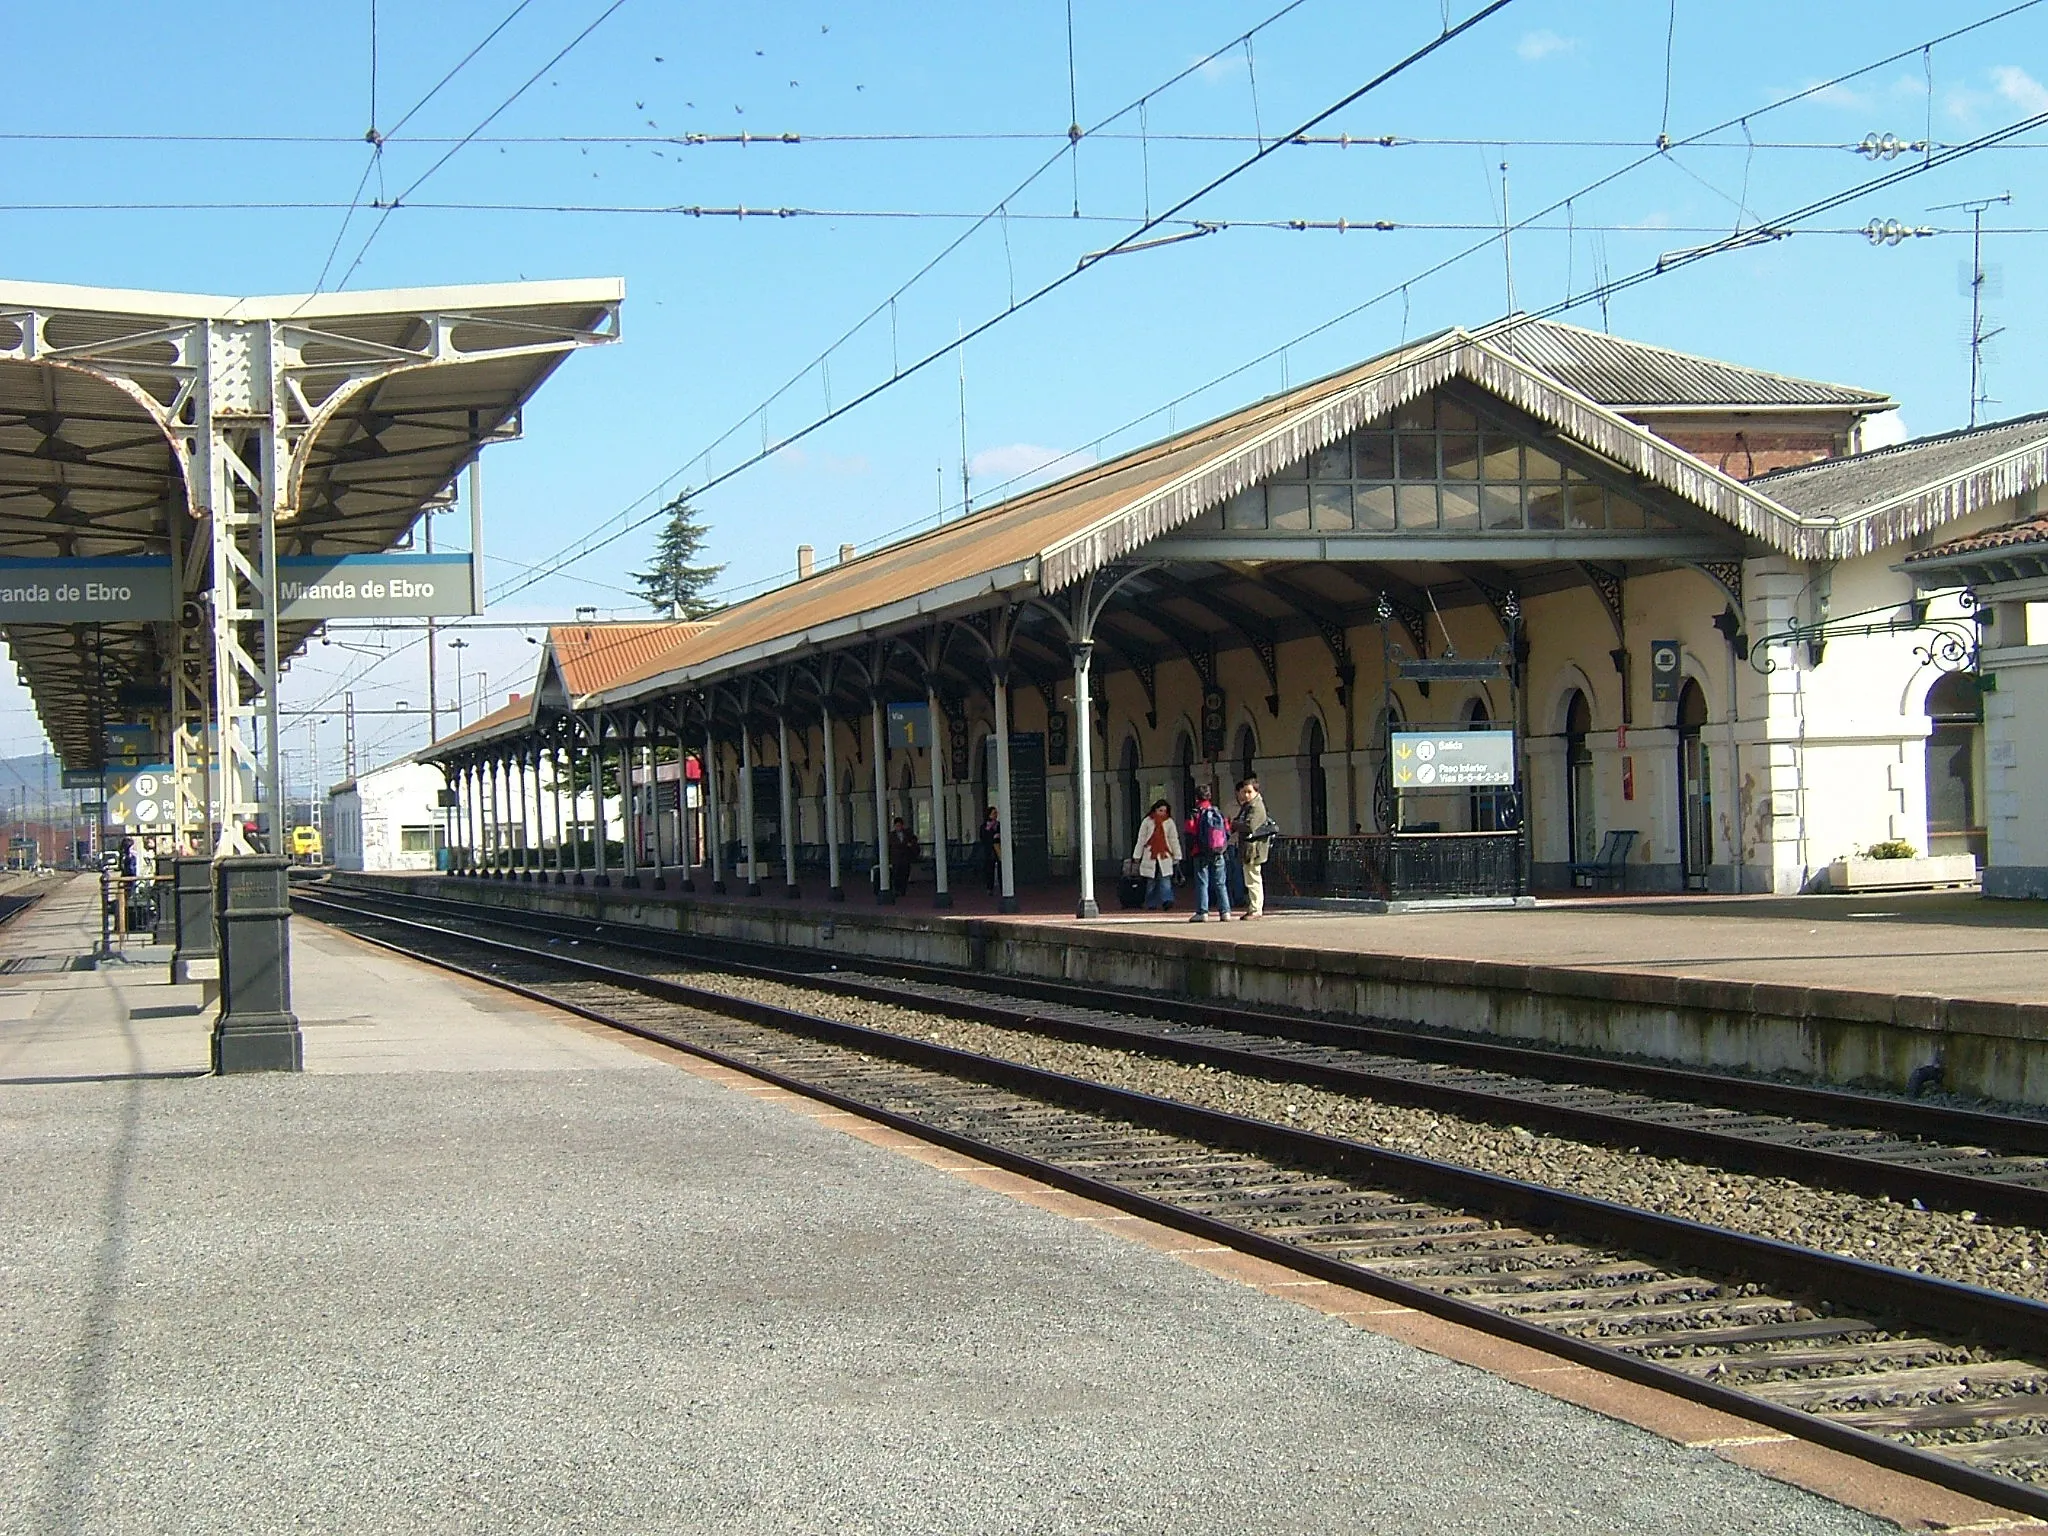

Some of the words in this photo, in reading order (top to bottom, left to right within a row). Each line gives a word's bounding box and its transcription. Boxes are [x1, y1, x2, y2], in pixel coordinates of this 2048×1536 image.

[55, 584, 81, 601] de
[85, 583, 131, 601] Ebro
[281, 580, 356, 600] Miranda
[360, 580, 385, 599] de
[389, 579, 434, 598] Ebro
[903, 722, 914, 744] 1
